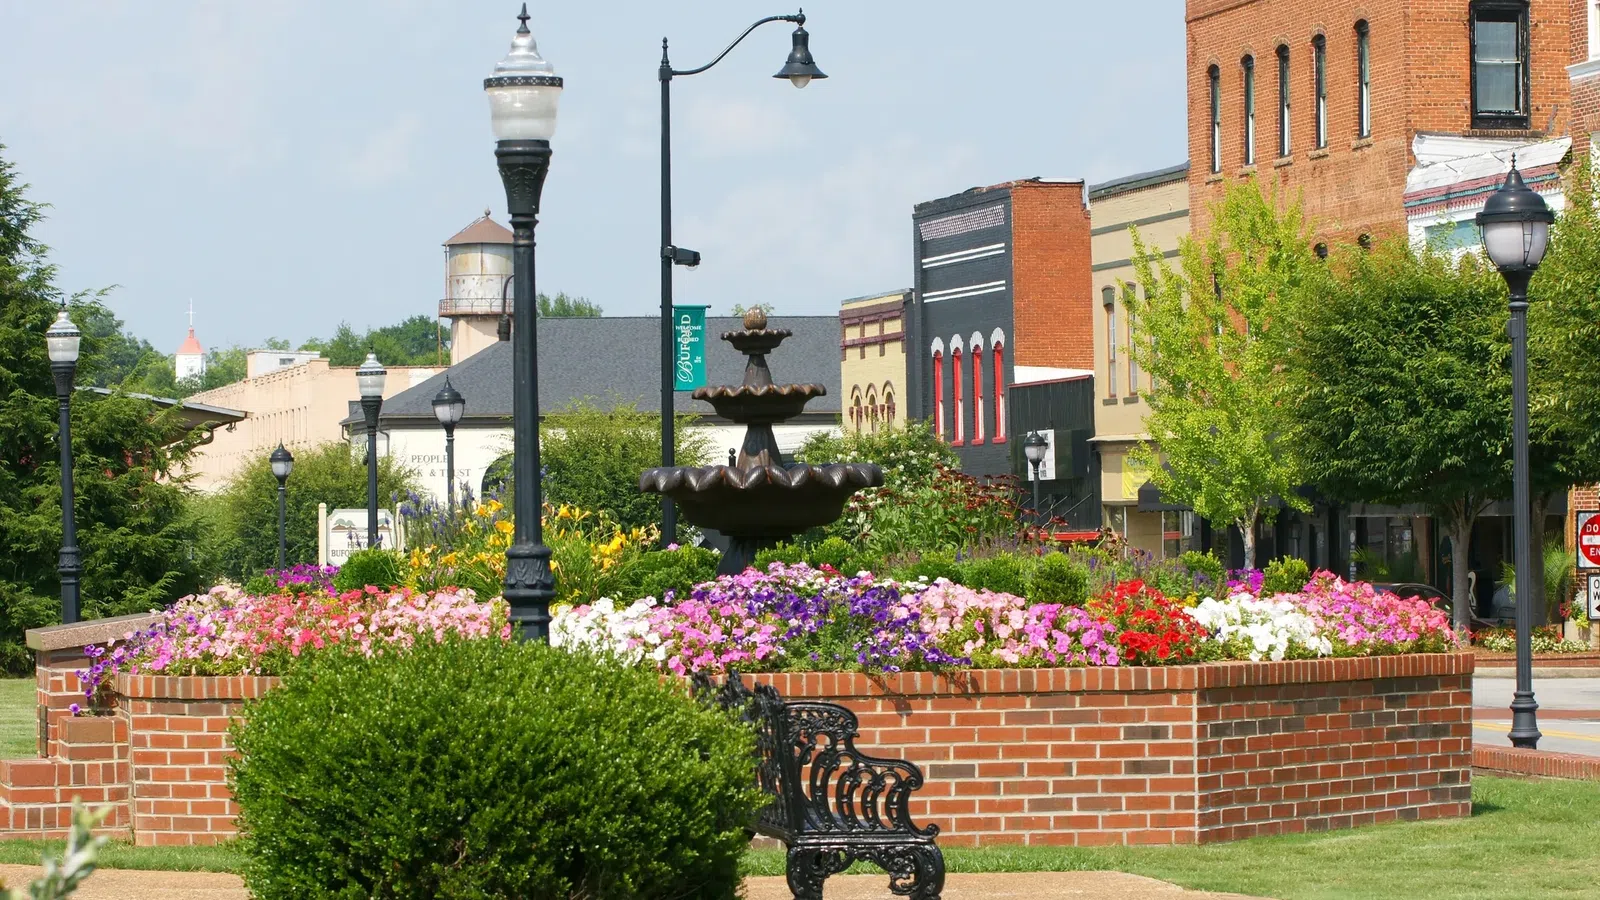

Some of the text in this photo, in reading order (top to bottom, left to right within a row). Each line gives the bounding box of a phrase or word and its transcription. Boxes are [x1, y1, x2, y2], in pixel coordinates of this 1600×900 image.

[411, 454, 449, 463] PEOPLE
[429, 468, 437, 478] &
[1586, 524, 1600, 533] DO
